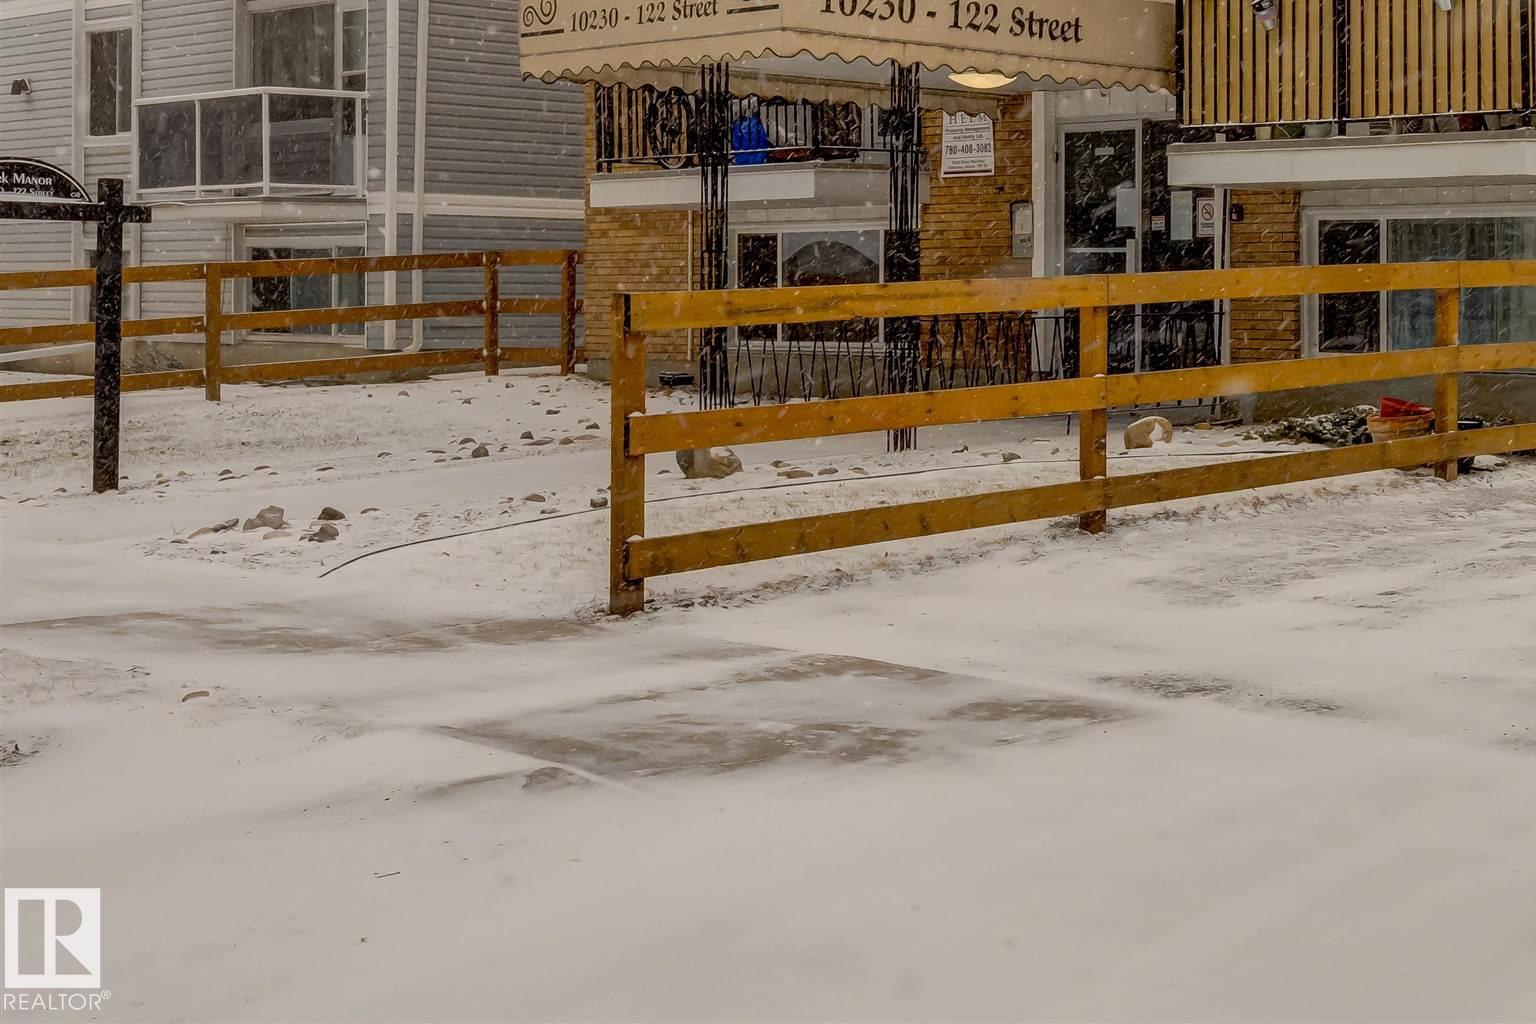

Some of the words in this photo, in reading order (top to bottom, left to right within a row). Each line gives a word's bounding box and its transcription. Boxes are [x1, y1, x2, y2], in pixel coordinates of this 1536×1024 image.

[570, 7, 619, 33] 10230
[637, 1, 667, 25] 122
[926, 10, 937, 18] -
[948, 0, 1000, 35] 122
[1009, 6, 1084, 44] Street
